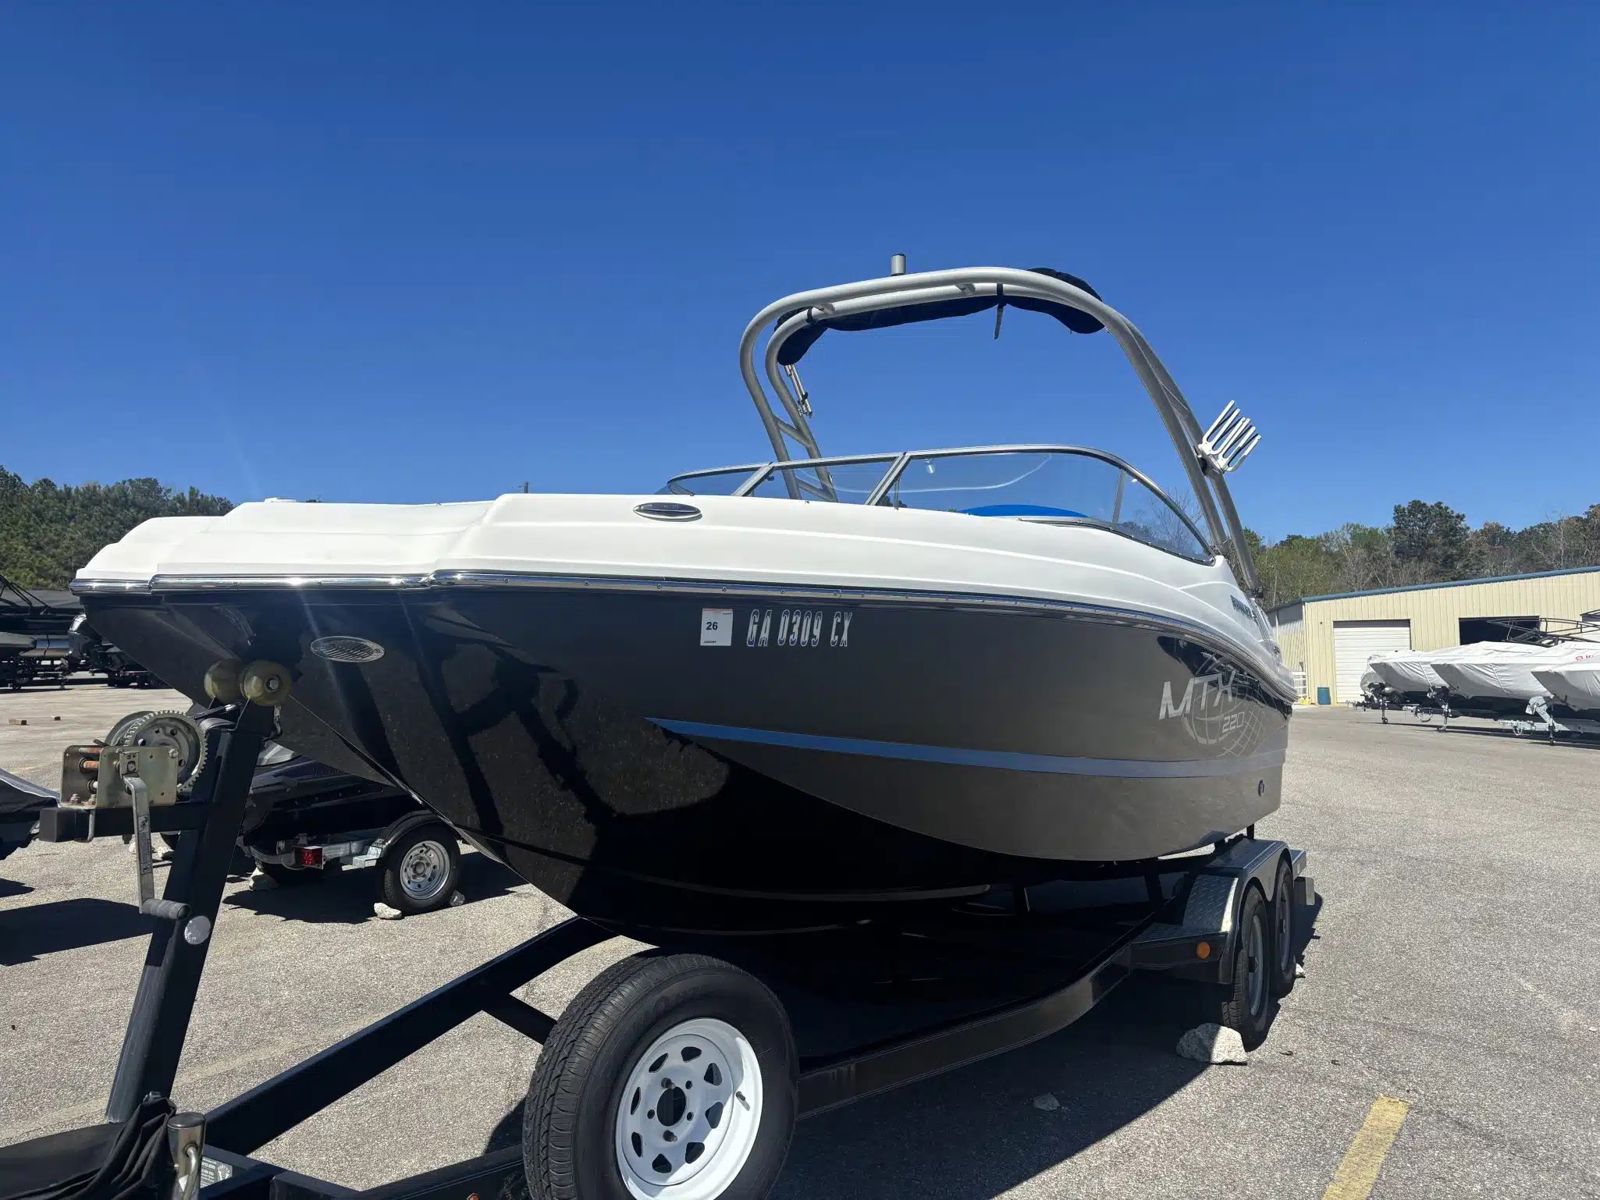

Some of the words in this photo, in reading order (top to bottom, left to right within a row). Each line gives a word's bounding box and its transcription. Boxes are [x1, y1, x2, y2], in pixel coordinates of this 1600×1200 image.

[705, 621, 718, 631] 26
[747, 609, 772, 647] GA
[777, 609, 823, 647] 0309
[830, 611, 853, 647] CX
[1158, 669, 1236, 720] MTX
[1221, 711, 1245, 733] 220
